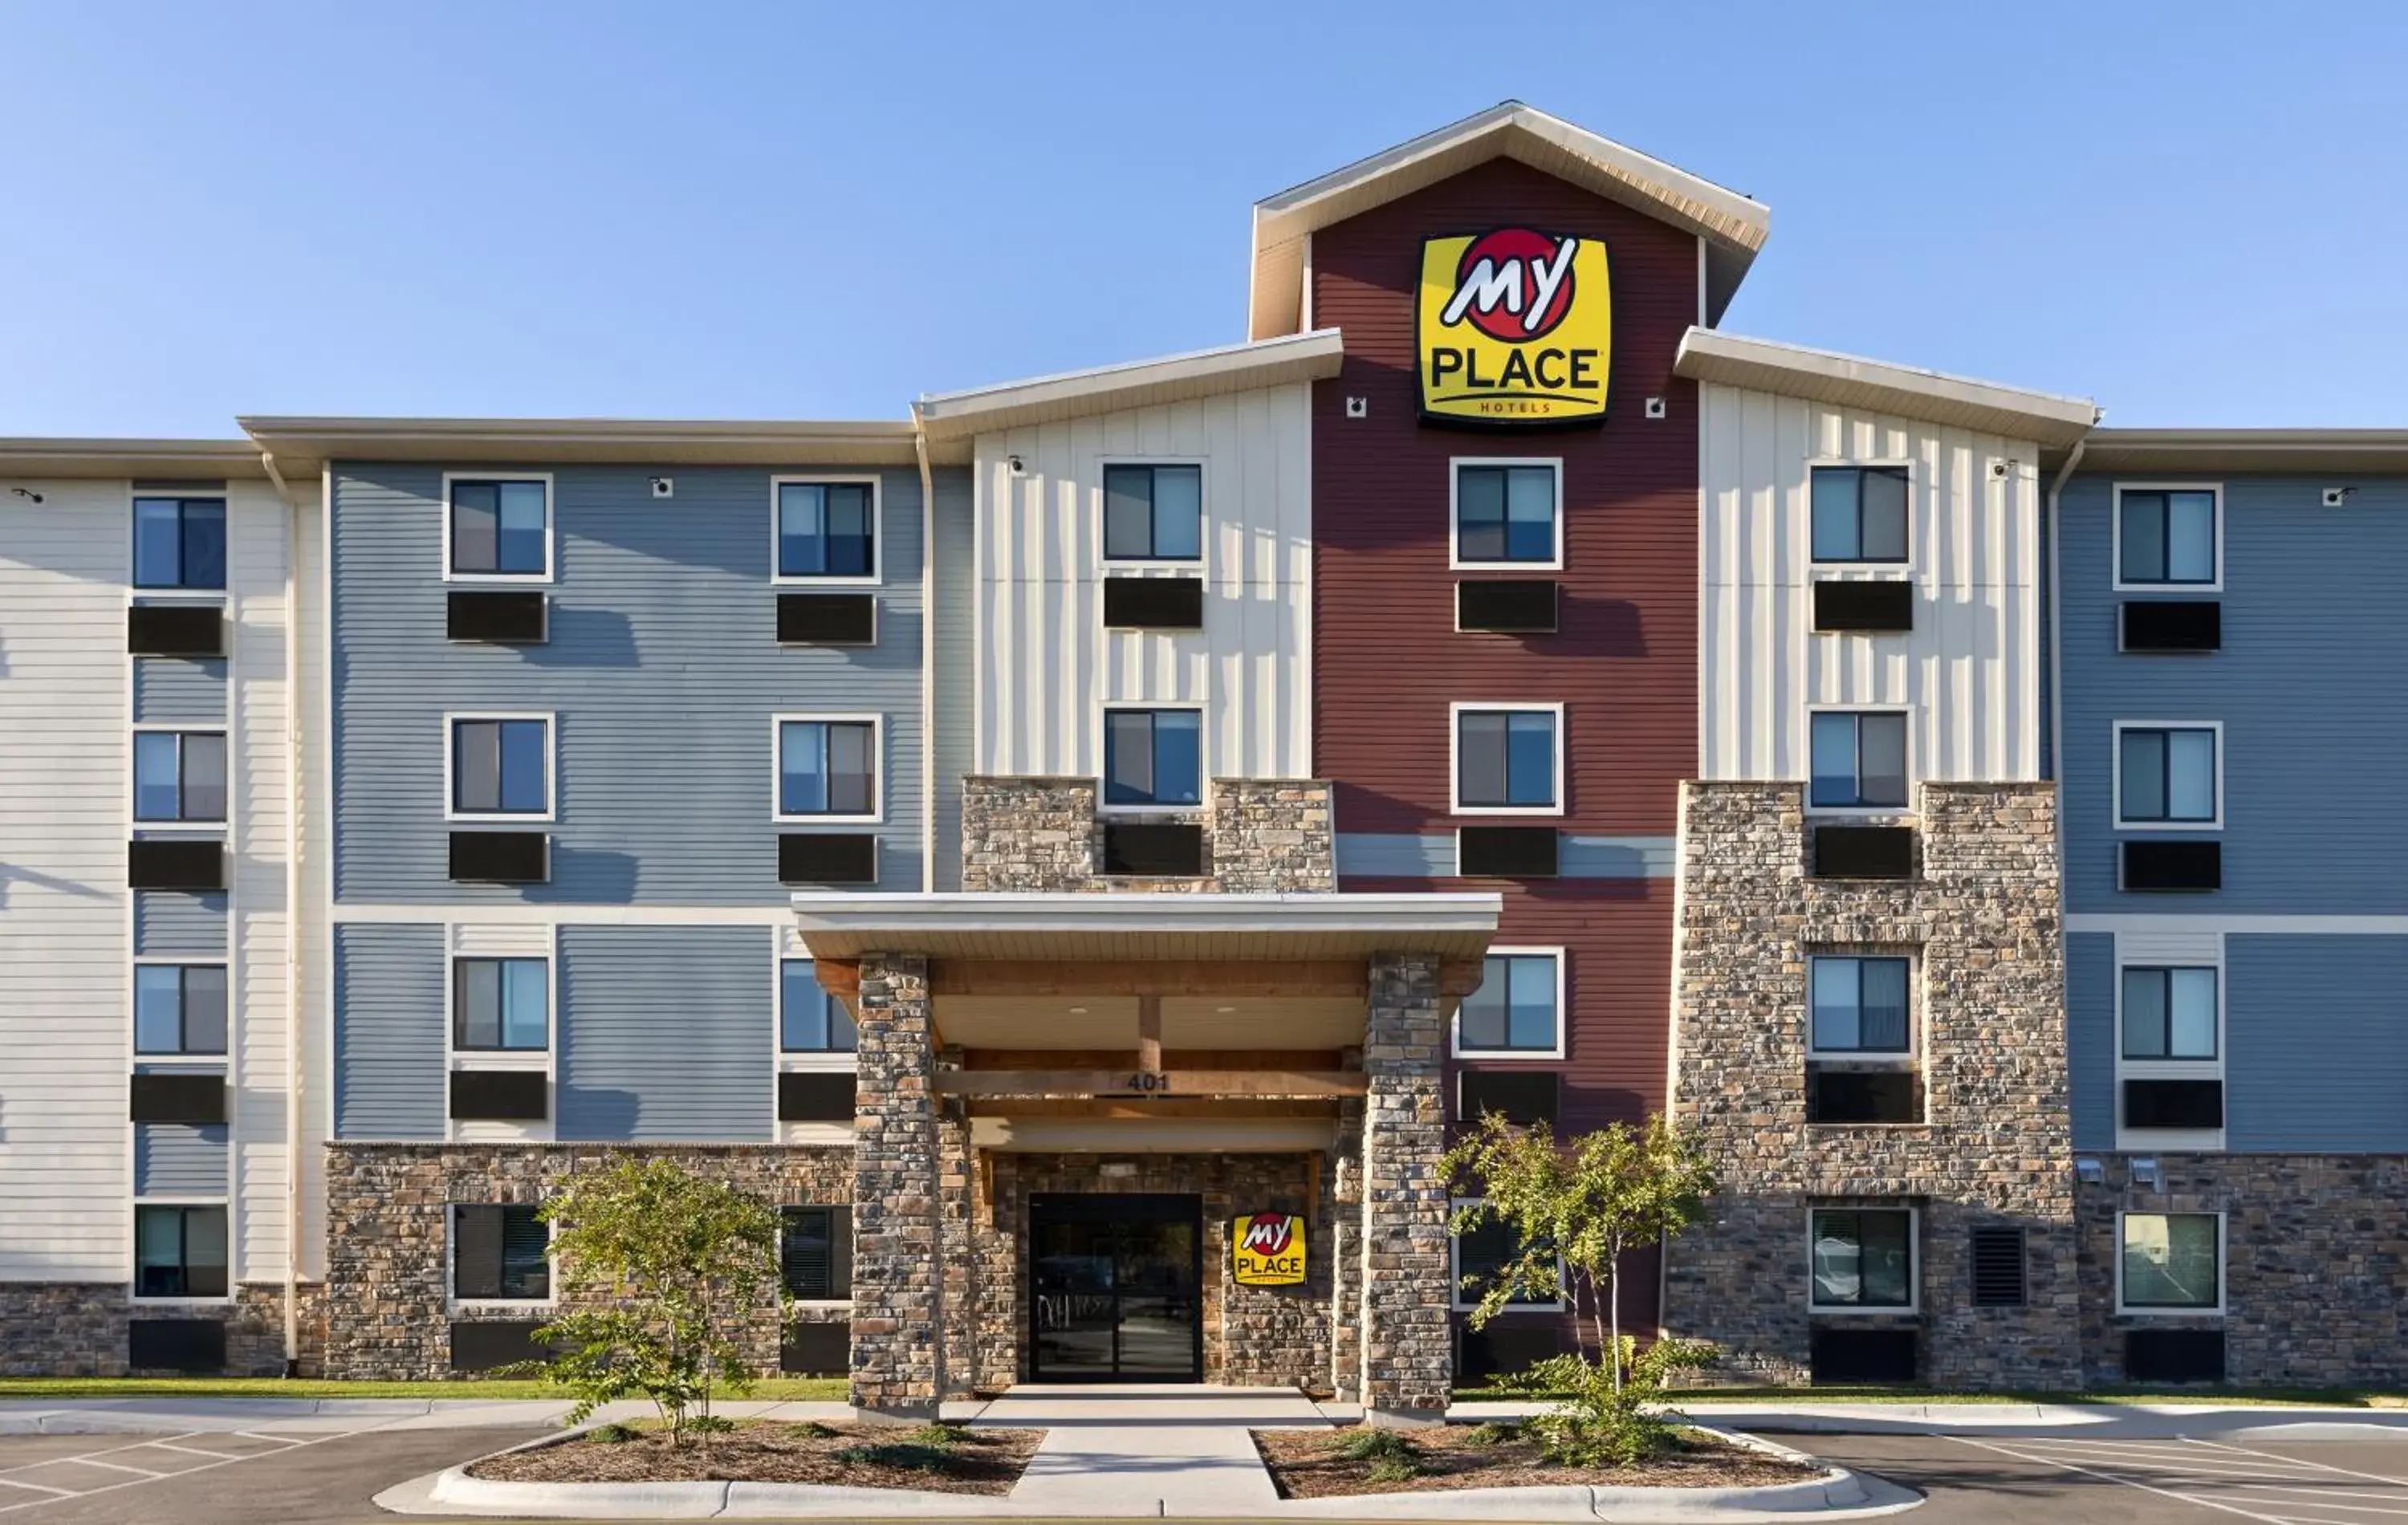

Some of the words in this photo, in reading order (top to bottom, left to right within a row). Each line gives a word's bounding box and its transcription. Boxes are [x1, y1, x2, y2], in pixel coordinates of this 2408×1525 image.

[1431, 348, 1599, 389] PLACE
[1480, 402, 1552, 413] HOTELS
[1127, 1073, 1167, 1091] 401
[1238, 1258, 1302, 1274] PLACE
